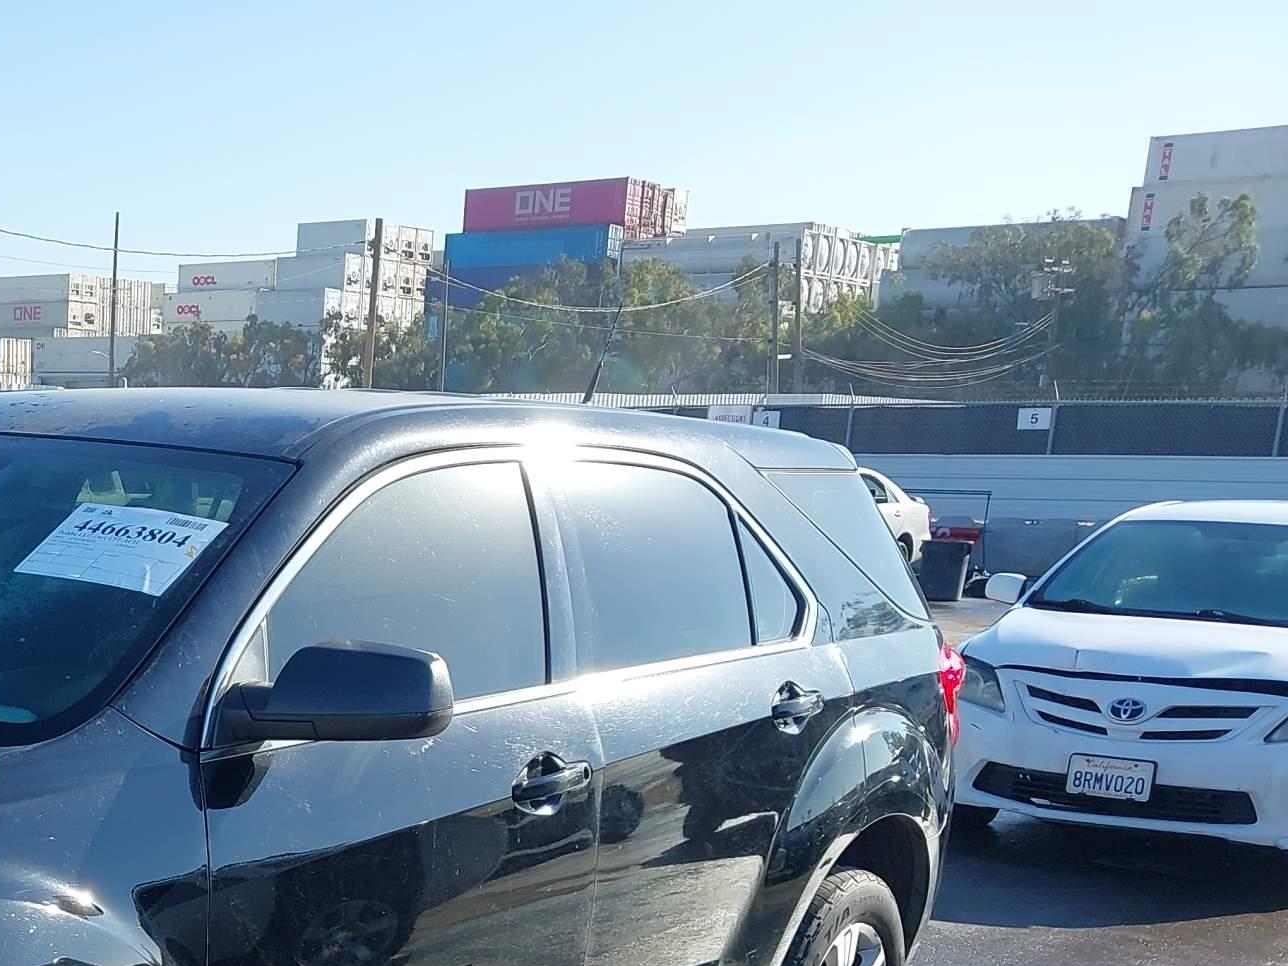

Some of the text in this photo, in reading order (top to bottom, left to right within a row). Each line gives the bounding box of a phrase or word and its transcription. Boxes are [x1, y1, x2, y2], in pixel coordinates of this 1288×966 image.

[515, 188, 572, 215] ONE
[192, 275, 217, 286] OOCL
[13, 306, 41, 320] ONE
[177, 304, 202, 315] OOCL
[761, 415, 770, 427] 4
[1030, 413, 1039, 425] 5
[74, 518, 193, 548] 44663804
[1086, 760, 1135, 772] California
[1073, 770, 1145, 796] 8RMV020
